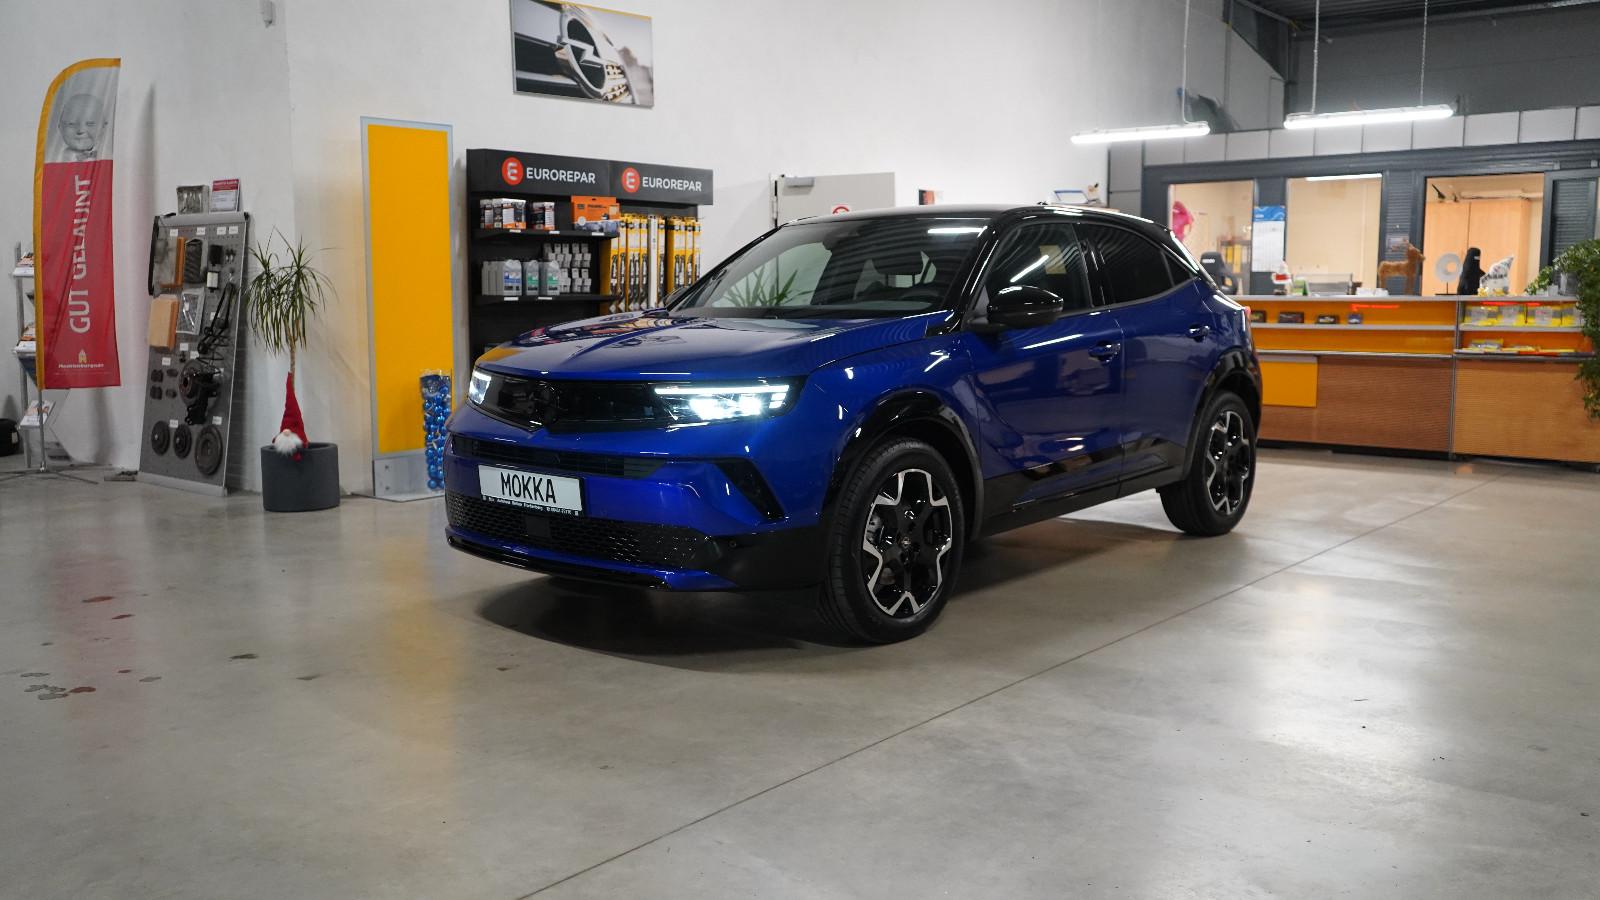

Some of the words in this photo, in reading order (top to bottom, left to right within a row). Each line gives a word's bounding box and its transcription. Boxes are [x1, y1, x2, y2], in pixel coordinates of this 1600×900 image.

[526, 167, 596, 184] EUROREPAR
[642, 176, 702, 192] EUROREPAR
[68, 286, 91, 334] GUT
[500, 471, 557, 504] MOKKA
